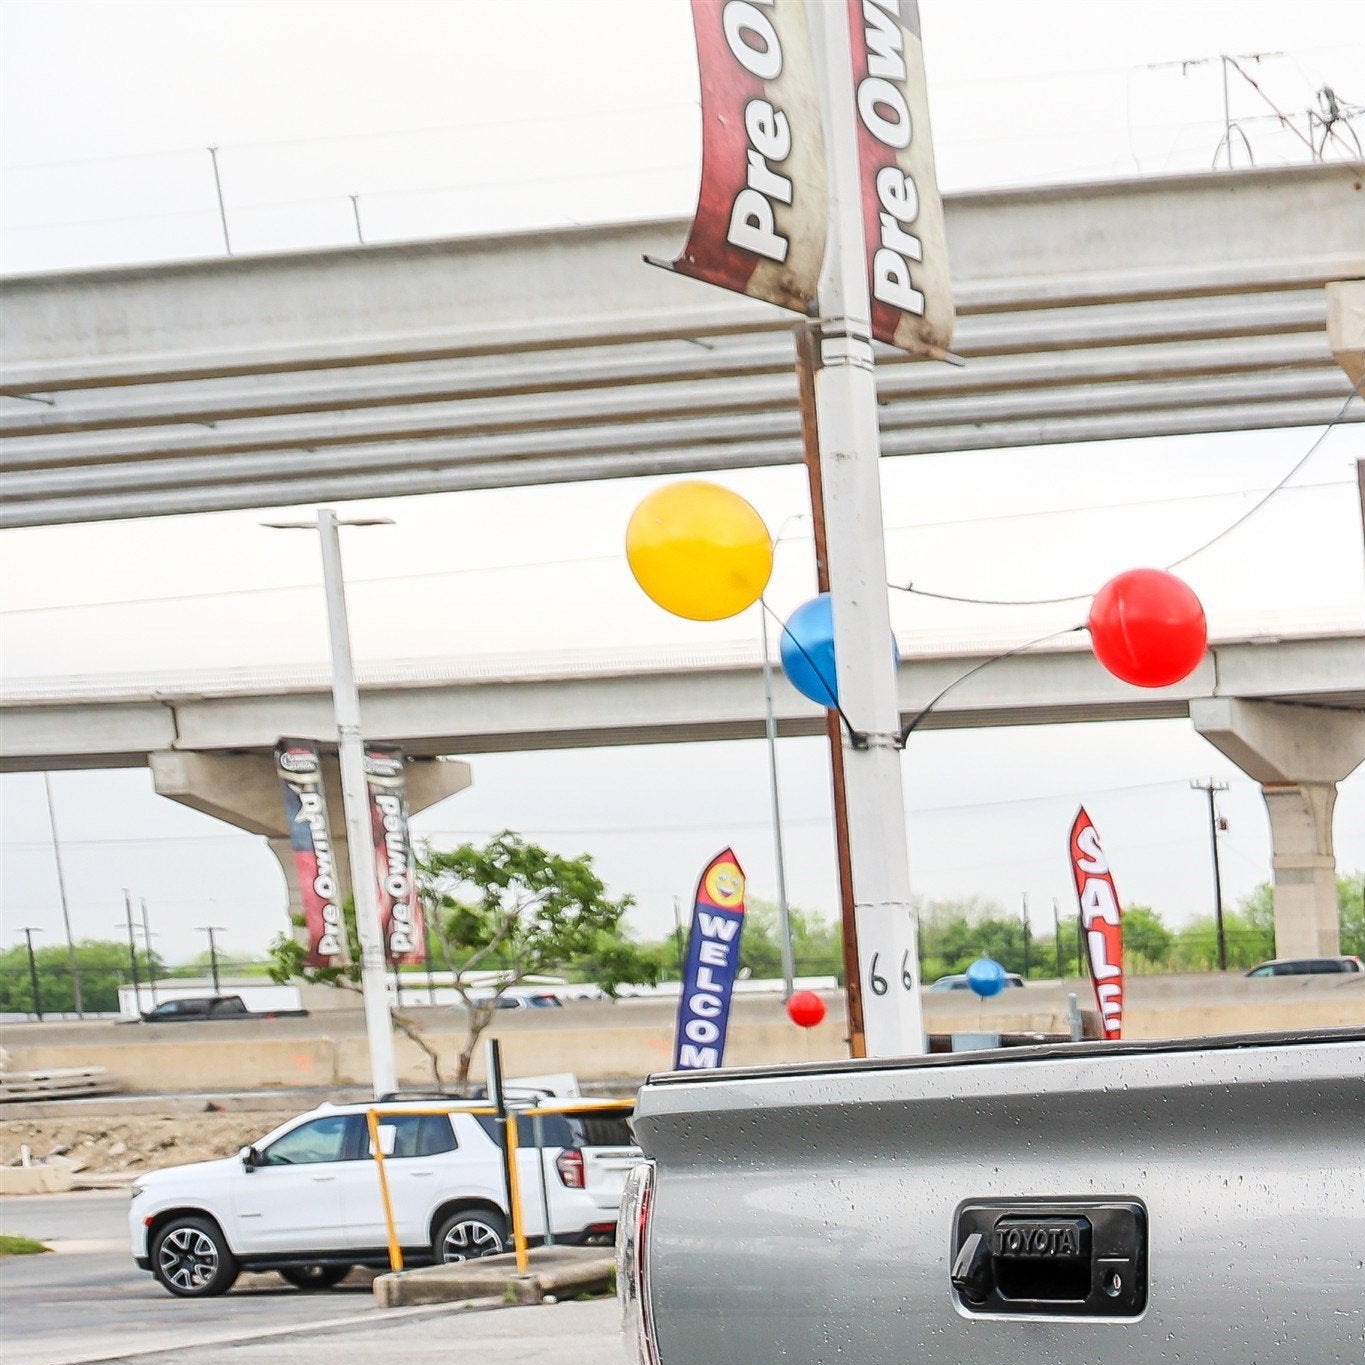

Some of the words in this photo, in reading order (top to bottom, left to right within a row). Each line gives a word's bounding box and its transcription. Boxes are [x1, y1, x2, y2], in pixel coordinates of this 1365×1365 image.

[721, 0, 784, 80] O
[726, 98, 793, 262] Pre
[873, 165, 926, 316] Pre
[299, 792, 336, 900] Owned
[375, 794, 410, 898] Owned
[317, 902, 342, 955] Pre
[390, 902, 415, 953] Pre
[1076, 824, 1122, 1032] SALE
[997, 1228, 1079, 1254] TOYOTA
